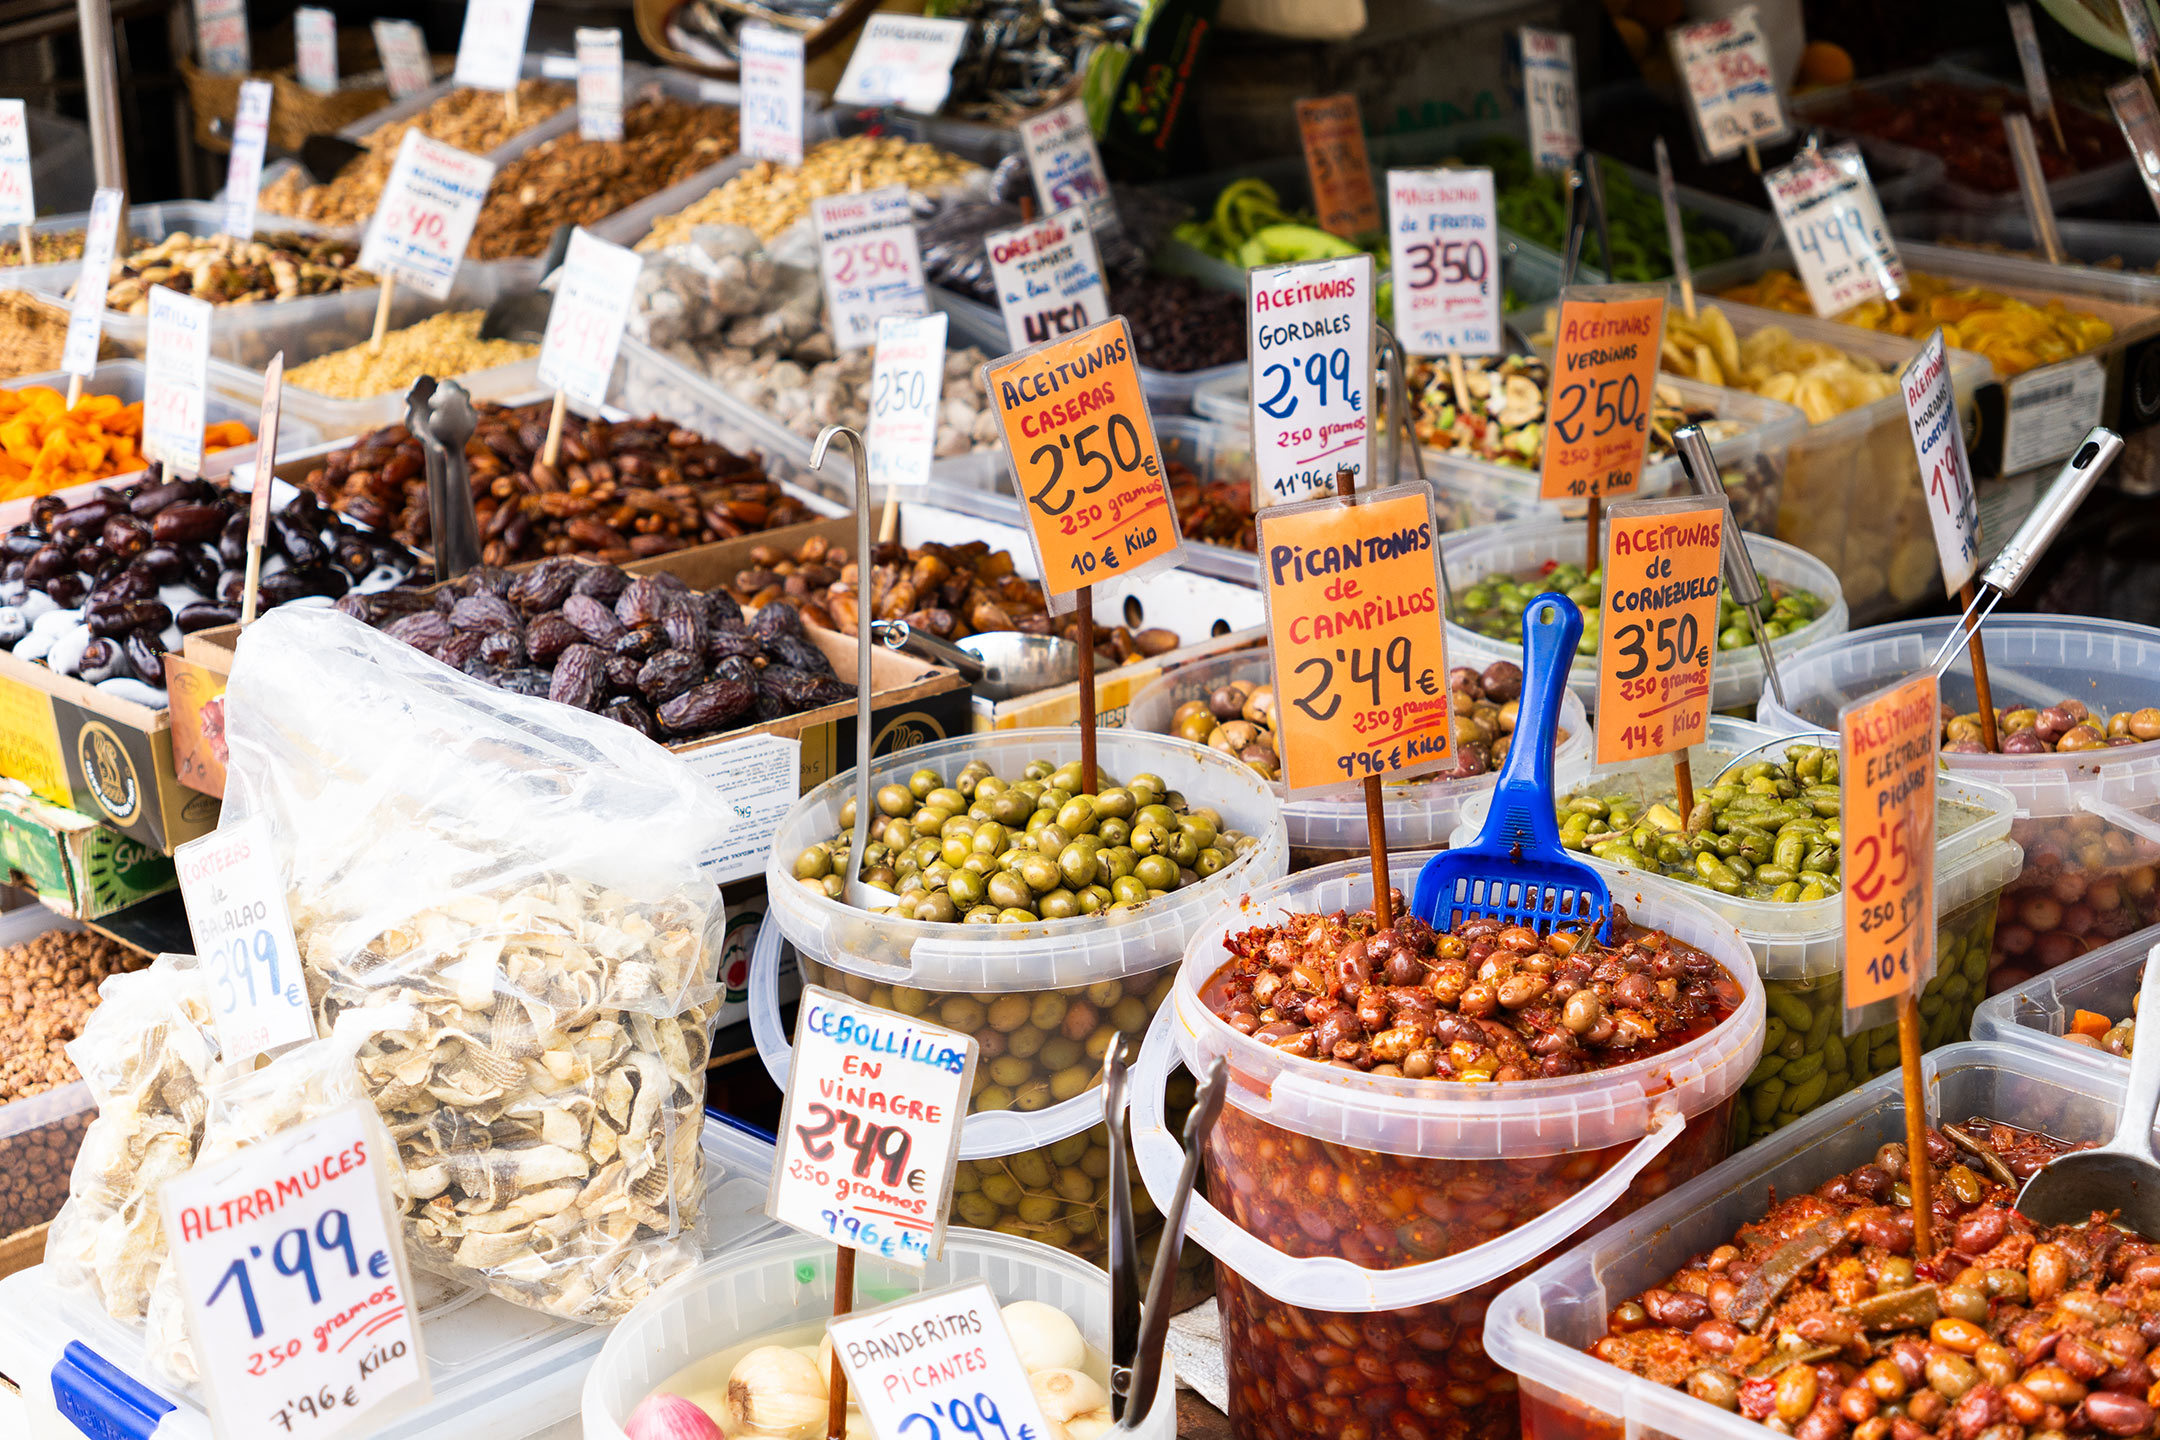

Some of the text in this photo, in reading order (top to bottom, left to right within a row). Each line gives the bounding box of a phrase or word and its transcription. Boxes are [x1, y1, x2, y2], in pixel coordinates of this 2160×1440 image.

[1406, 237, 1489, 296] 3'50€
[1258, 314, 1351, 351] GORDALES
[1258, 347, 1362, 419] 2'99€
[1020, 381, 1116, 438] CASERAS
[1276, 415, 1367, 449] 250 gramos
[1554, 373, 1646, 445] 2'50€
[1029, 413, 1160, 516] 2'50€
[1558, 449, 1589, 466] 250
[1060, 479, 1164, 536] 250 gramos
[1567, 479, 1587, 497] 10
[1070, 551, 1096, 576] 10
[1100, 547, 1120, 569] €
[1646, 555, 1672, 579] de
[1323, 577, 1364, 602] de
[1612, 574, 1719, 614] CORNEZUELO
[1613, 612, 1710, 682] 3'50€
[1292, 636, 1440, 723] 2'49€
[1618, 667, 1708, 703] 250 gramos
[1353, 695, 1448, 735] 250 gramos
[1620, 724, 1648, 750] 14
[183, 839, 252, 886] CORTEZAS
[210, 883, 229, 907] de
[1859, 900, 1895, 933] 250
[199, 899, 268, 945] BACALAO
[210, 928, 304, 1015] 3'99€
[231, 1026, 271, 1058] BOLSA
[842, 1055, 882, 1080] EN
[795, 1101, 926, 1194] 2'49€
[180, 1141, 367, 1243] ALTRAMUCES
[788, 1158, 928, 1215] 250 gramos
[205, 1209, 391, 1340] 1'99€
[247, 1285, 398, 1377] 250 gramos
